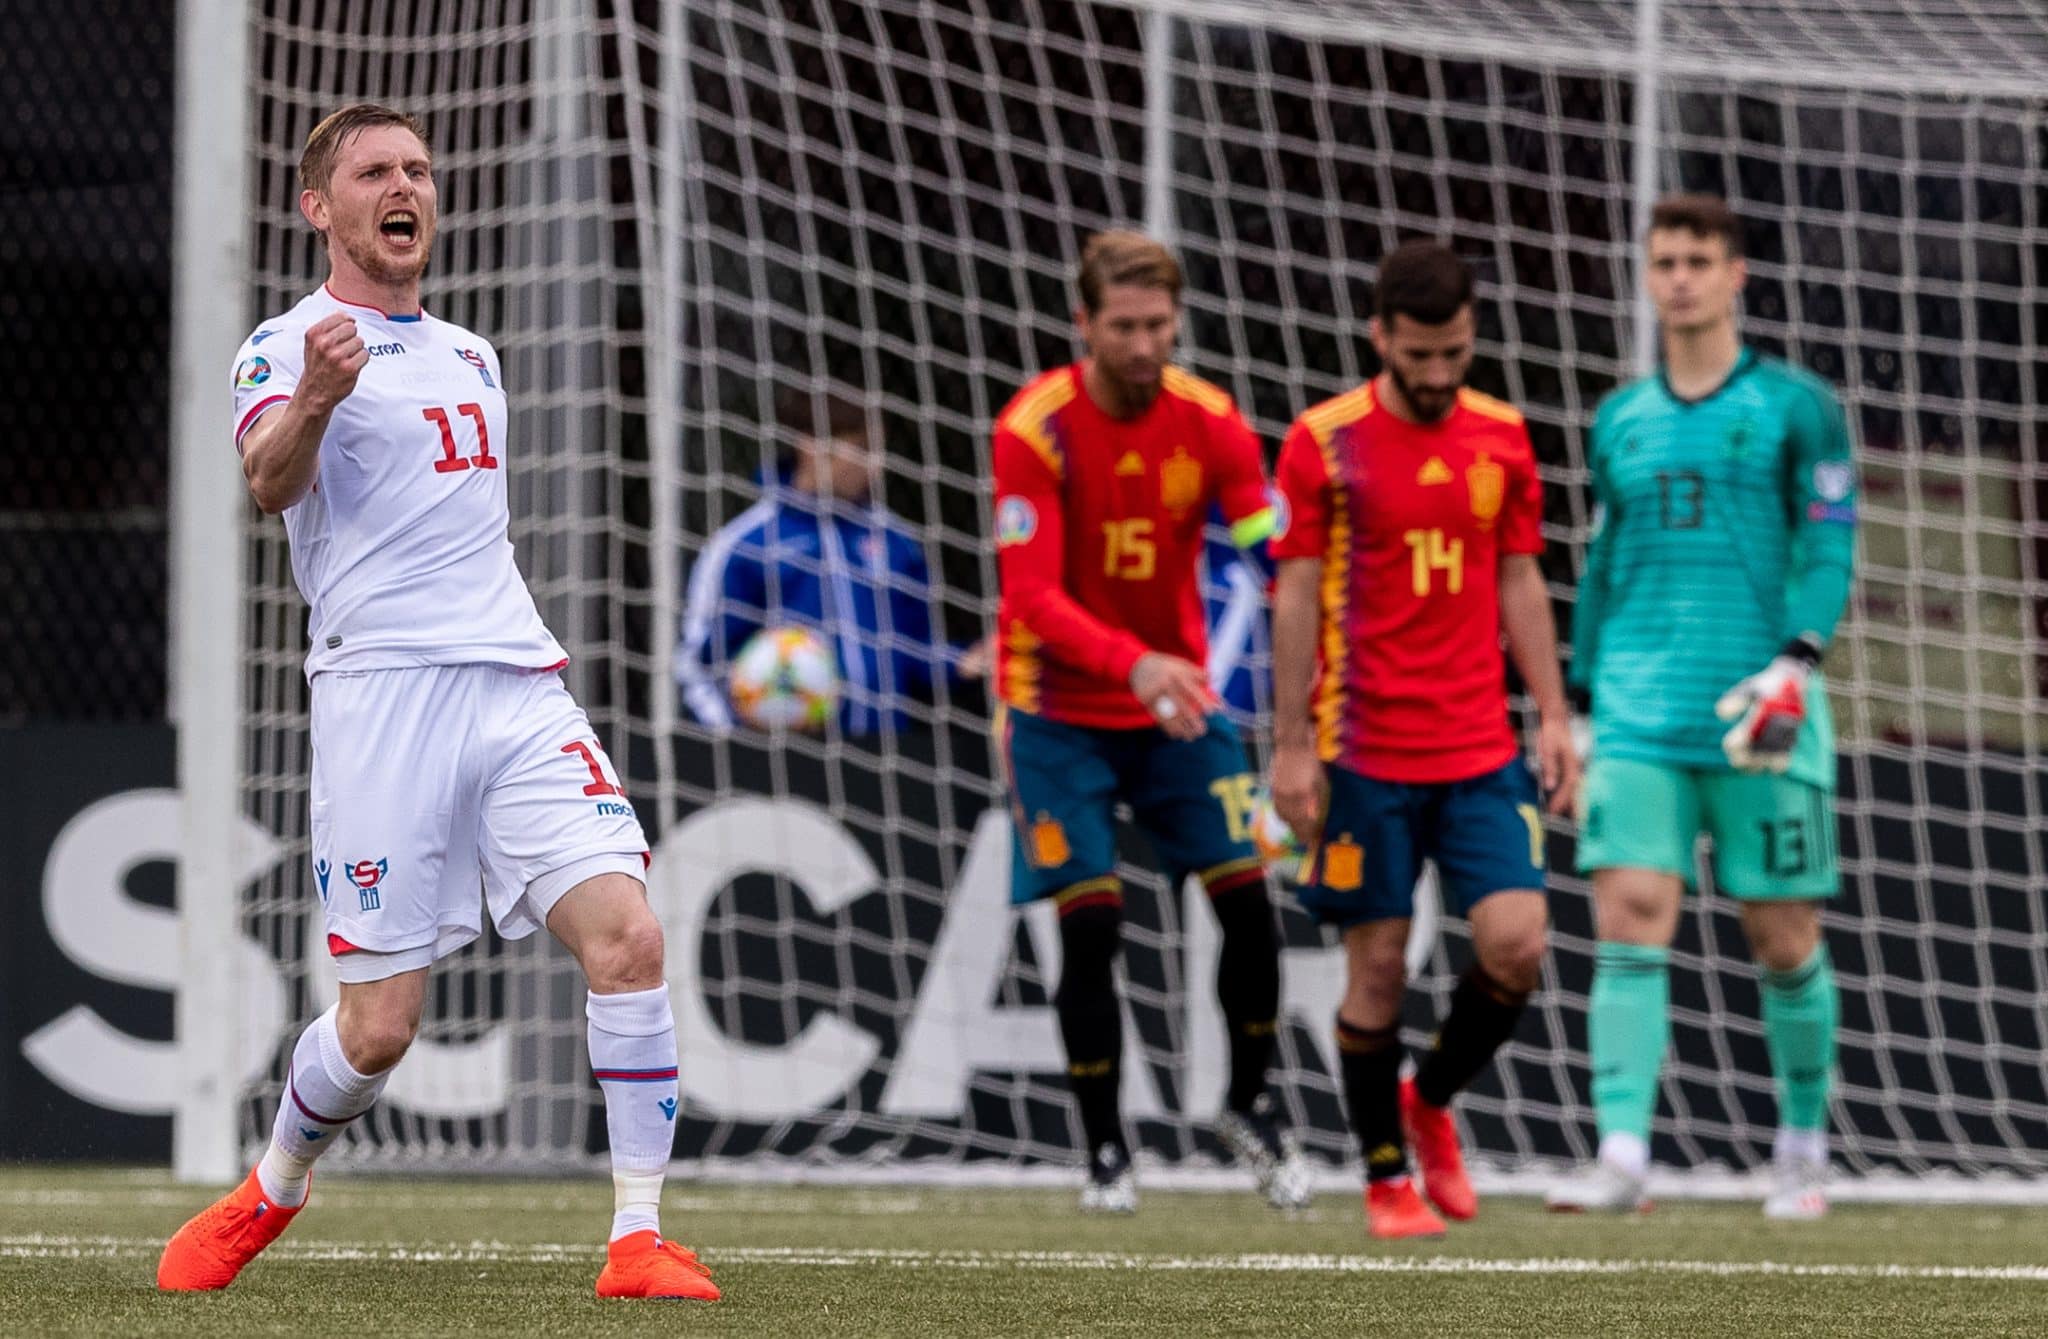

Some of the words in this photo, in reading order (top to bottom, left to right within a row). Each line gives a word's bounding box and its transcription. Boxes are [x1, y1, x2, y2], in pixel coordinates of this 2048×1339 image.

[368, 342, 406, 357] cron
[422, 402, 498, 473] 11
[1656, 469, 1705, 530] 13
[1103, 516, 1157, 581] 15
[1403, 527, 1464, 597] 14
[560, 739, 627, 797] 1
[1759, 819, 1807, 877] 13
[20, 786, 1438, 1122] SCA
